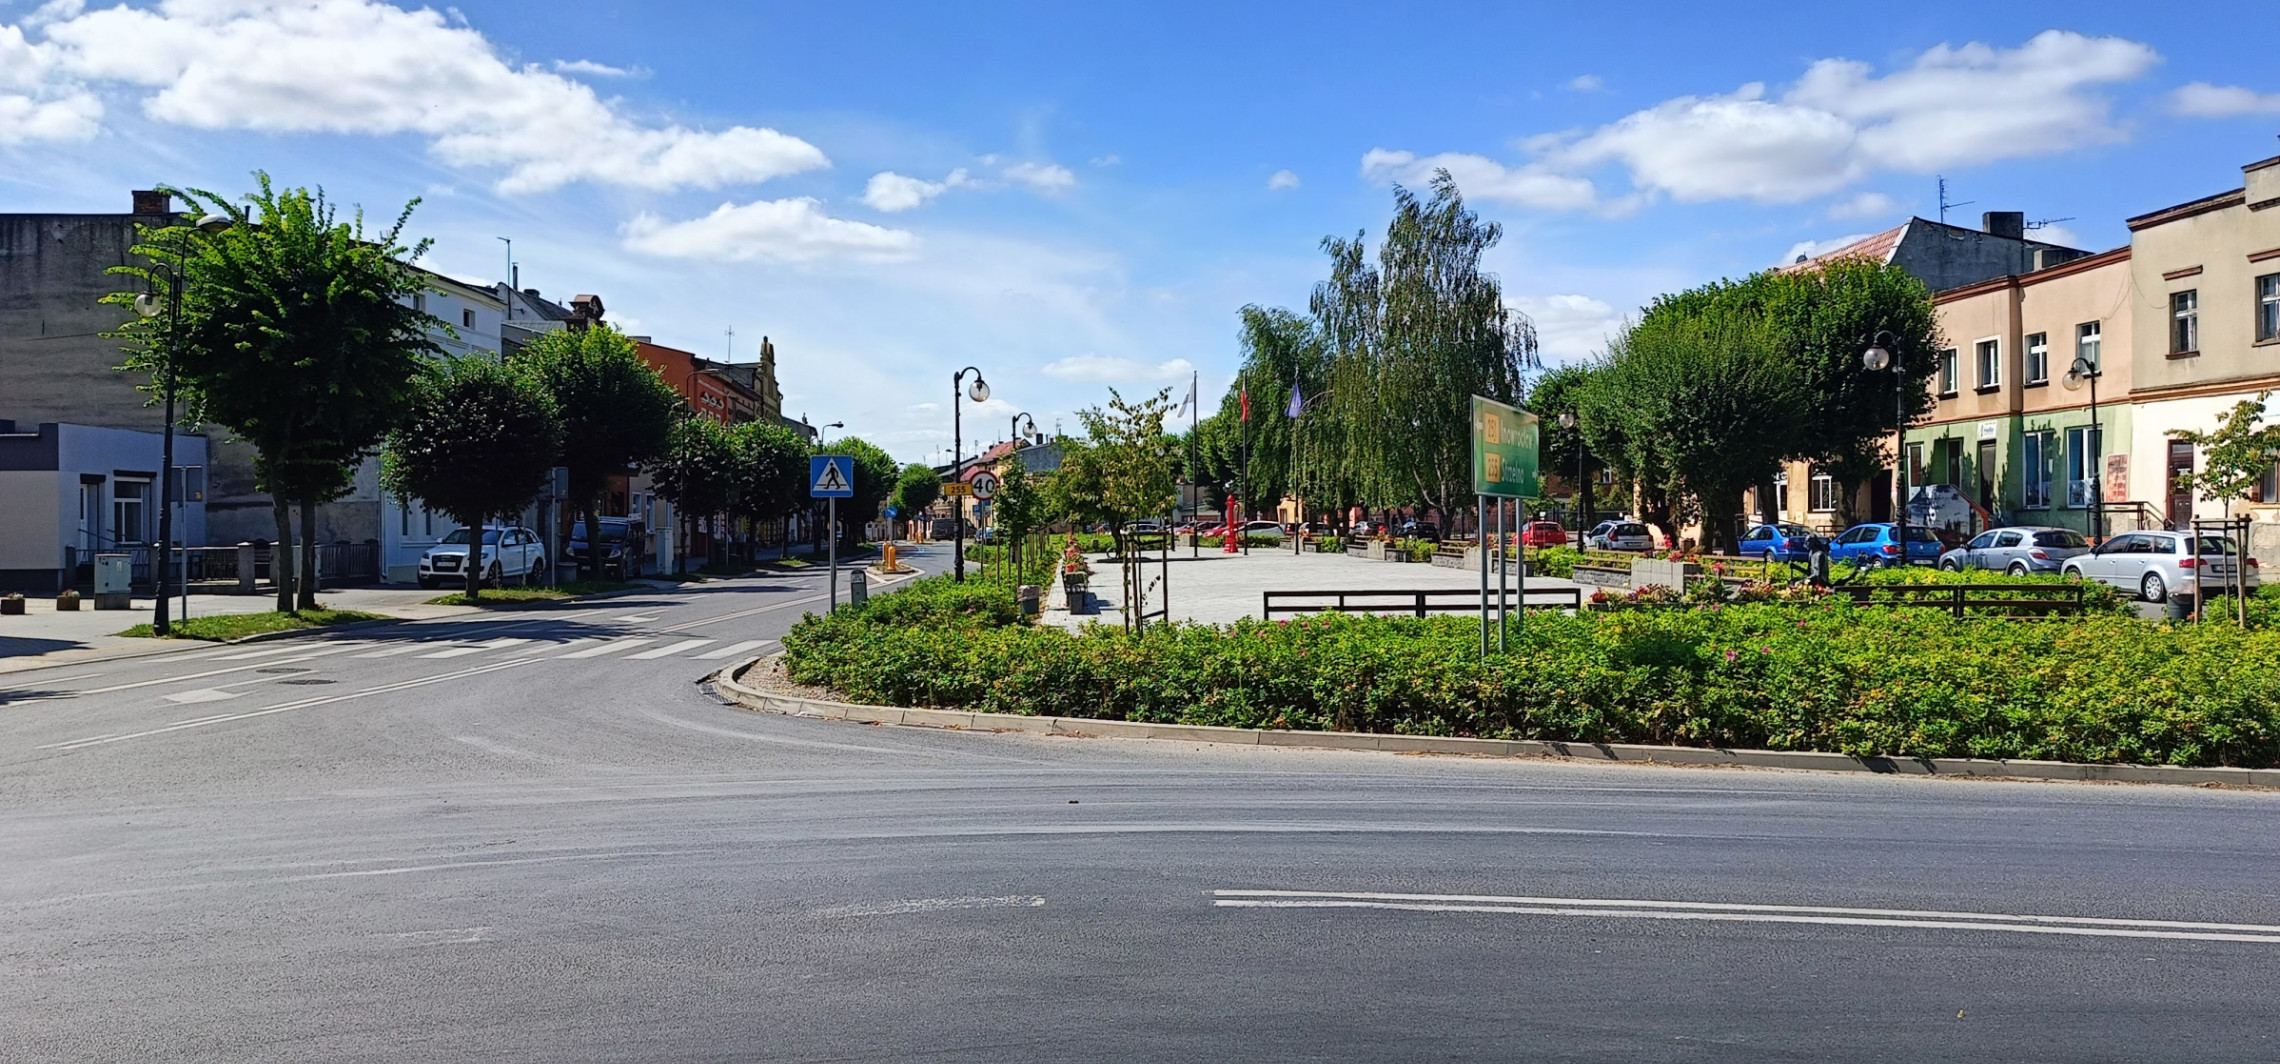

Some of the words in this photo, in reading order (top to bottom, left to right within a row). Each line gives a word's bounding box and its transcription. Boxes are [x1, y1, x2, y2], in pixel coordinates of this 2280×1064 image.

[1502, 458, 1525, 485] Strzelno
[951, 486, 967, 494] 255
[973, 478, 995, 494] 40
